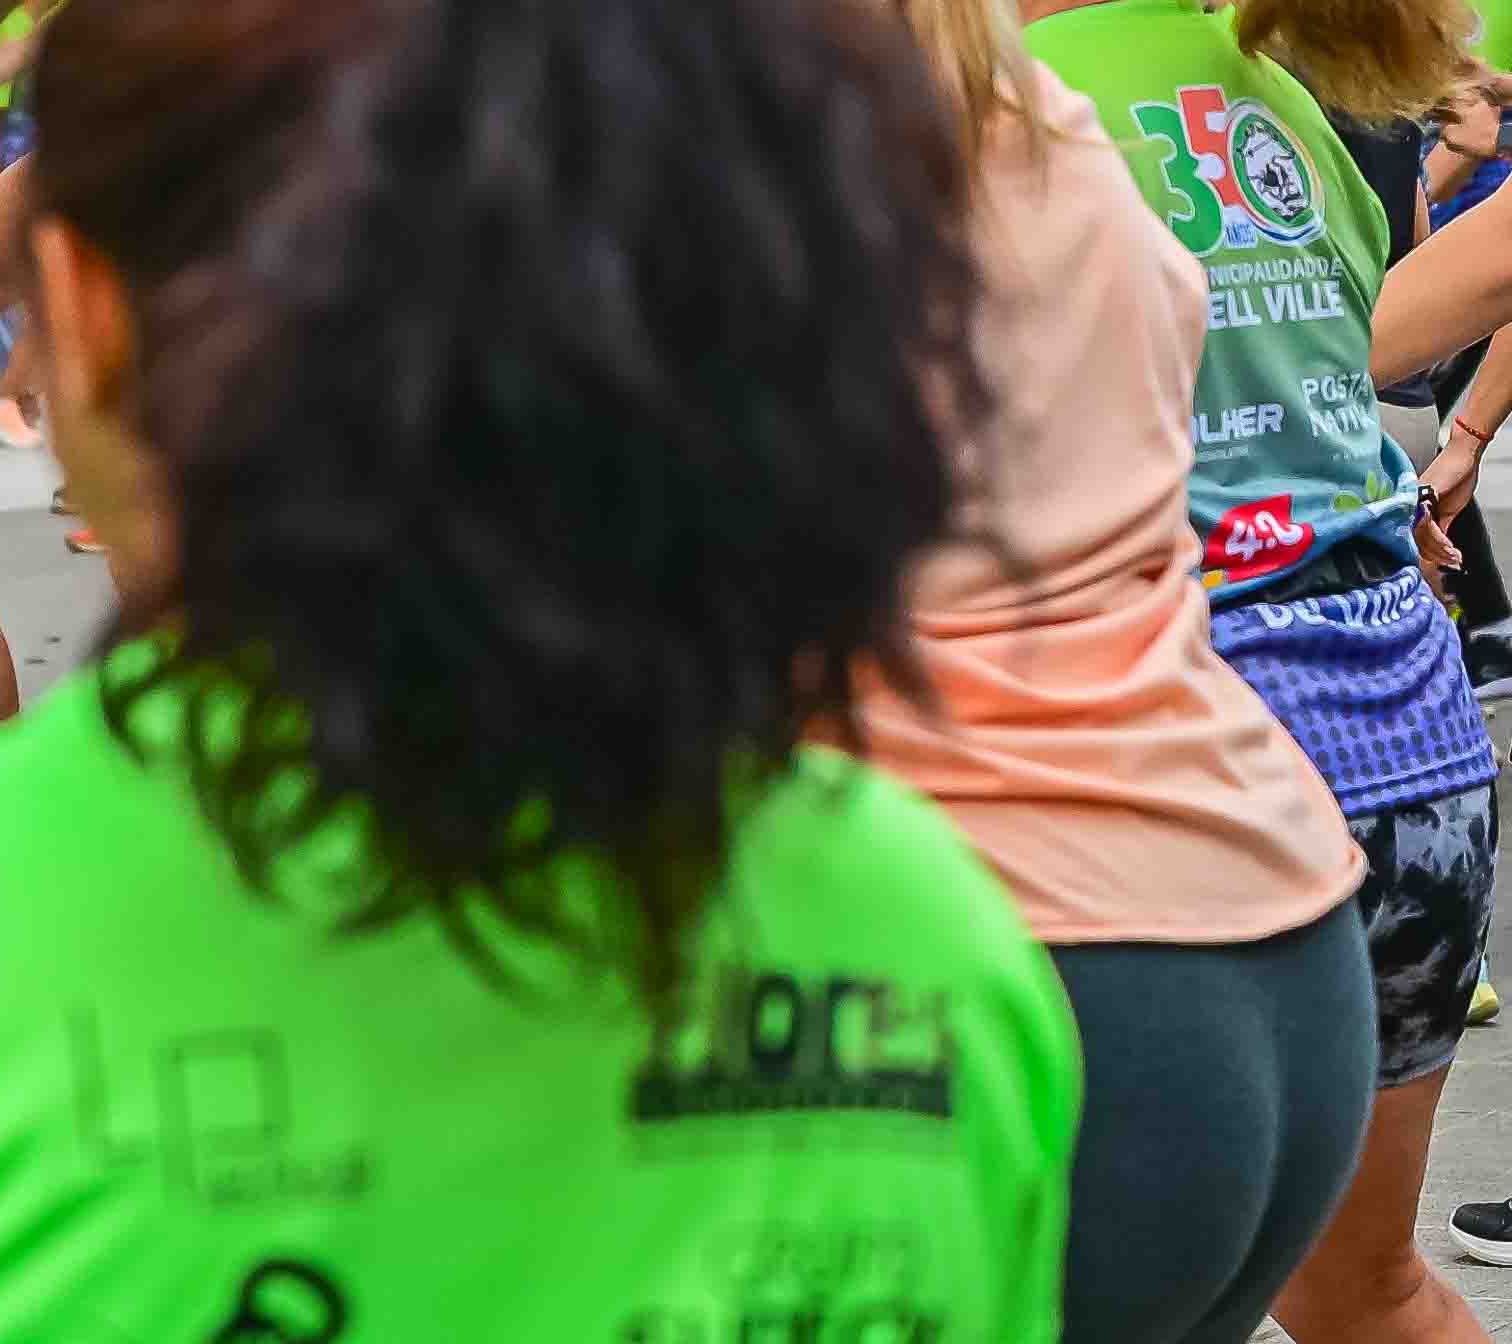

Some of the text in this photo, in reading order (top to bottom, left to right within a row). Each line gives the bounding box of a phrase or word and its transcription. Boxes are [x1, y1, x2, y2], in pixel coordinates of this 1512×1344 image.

[1207, 279, 1346, 331] ELL VILLE
[1192, 403, 1286, 445] LHER
